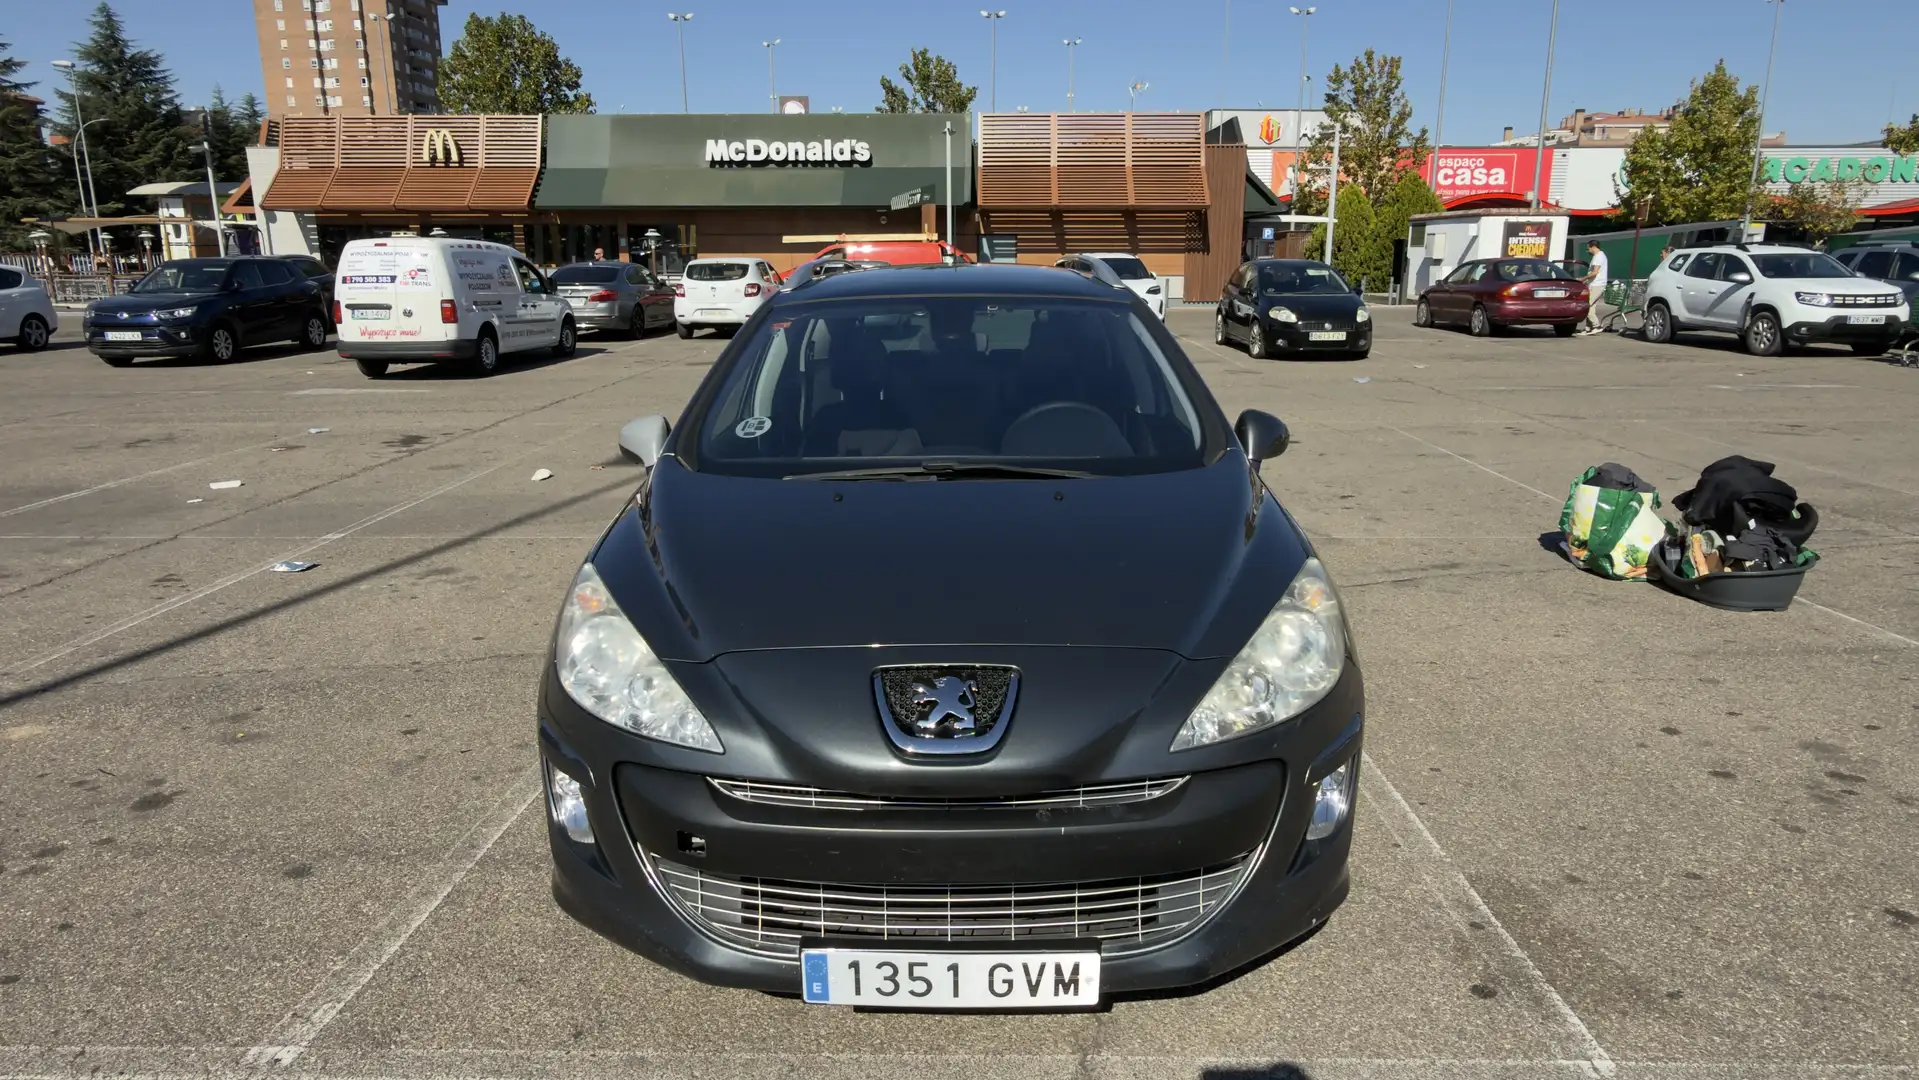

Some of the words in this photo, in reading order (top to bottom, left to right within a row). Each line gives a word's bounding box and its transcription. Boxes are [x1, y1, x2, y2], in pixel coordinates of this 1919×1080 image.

[705, 139, 871, 162] McDonald's
[1438, 157, 1485, 170] espaço
[1437, 167, 1506, 186] casa
[1508, 236, 1547, 245] INTENSE
[1507, 243, 1545, 256] CHEDDAR
[848, 959, 960, 998] 1351
[987, 961, 1081, 998] GVM
[812, 982, 822, 994] E
